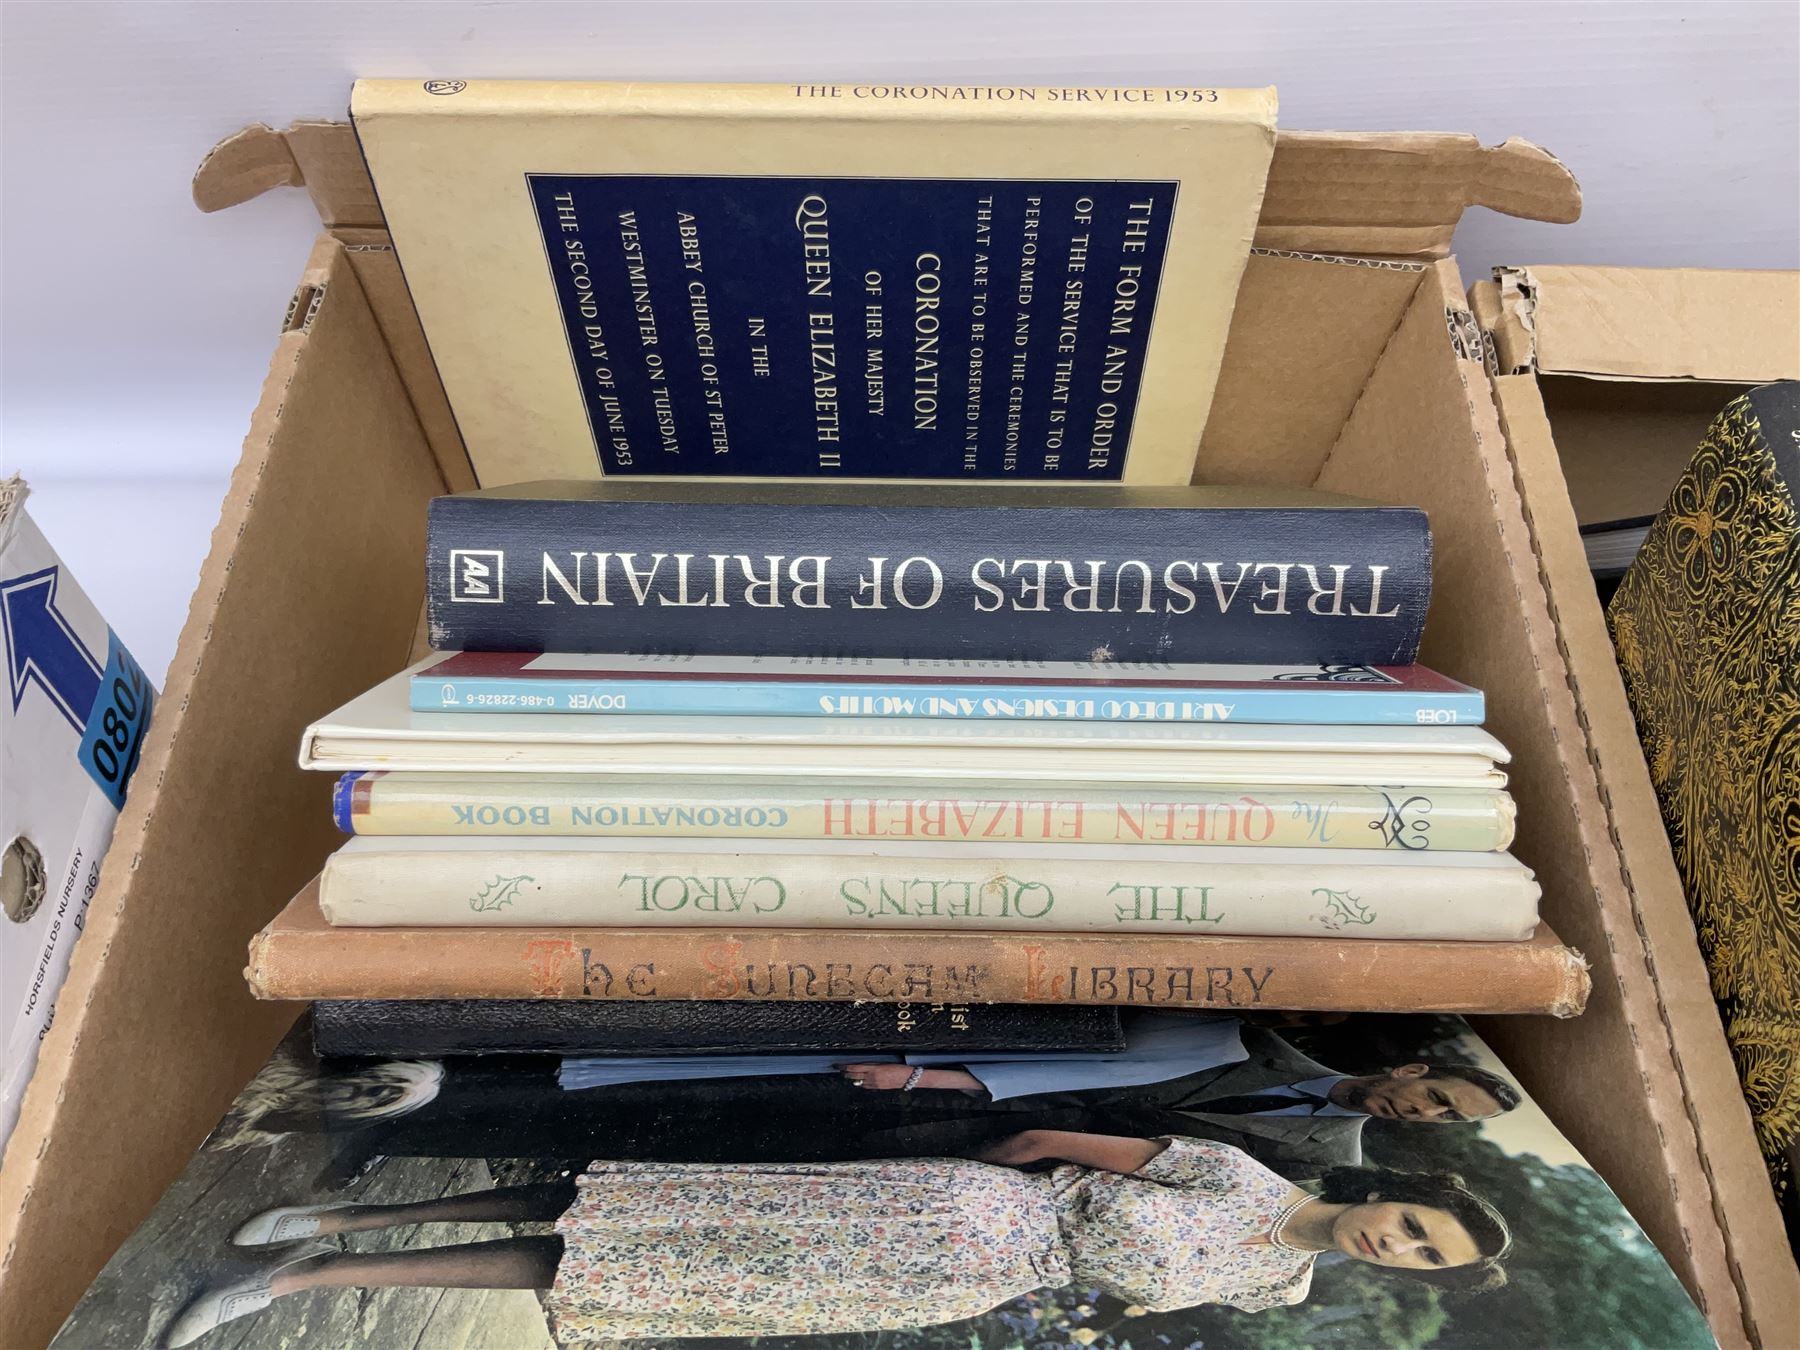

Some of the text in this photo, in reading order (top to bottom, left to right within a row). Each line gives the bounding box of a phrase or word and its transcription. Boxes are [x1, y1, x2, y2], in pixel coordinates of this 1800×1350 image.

[791, 85, 1218, 103] THE CORONATION SERVICE 1953
[555, 192, 633, 466] THE SECOND DAY OF JUNE 1953
[618, 210, 680, 454] WESTMINSTER ON TUESDAY
[677, 211, 729, 454] ABBEY CHURCH OF ST PETER
[748, 318, 770, 377] IN THE
[795, 195, 841, 467] QUEEN ELIZABETH II
[864, 271, 884, 416] OF HER MAJESTY
[914, 253, 941, 431] CORONATION
[963, 196, 993, 471] THAT ARE TO BE OBSERVED IN THE
[1003, 197, 1041, 471] PERFORMED AND THE CEREMONIES
[1043, 197, 1094, 471] OF THE SERVICE THAT IS TO BE
[1088, 198, 1153, 470] THE FORM AND ORDER
[463, 556, 490, 594] AA
[537, 551, 1401, 617] TREASURES OF BRITAIN
[466, 692, 626, 709] DOVER 0-486-22826-6
[819, 695, 1235, 720] ART DECO DESIGNS AND MOTIFS
[1416, 708, 1457, 723] LOEB
[451, 796, 1340, 843] The QUEEN ELIZABETH CORONATION BOOK
[25, 919, 61, 1016] HORSFIELDS
[59, 847, 84, 918] NURSERY
[617, 872, 787, 913] CAROL
[1106, 882, 1225, 924] THE
